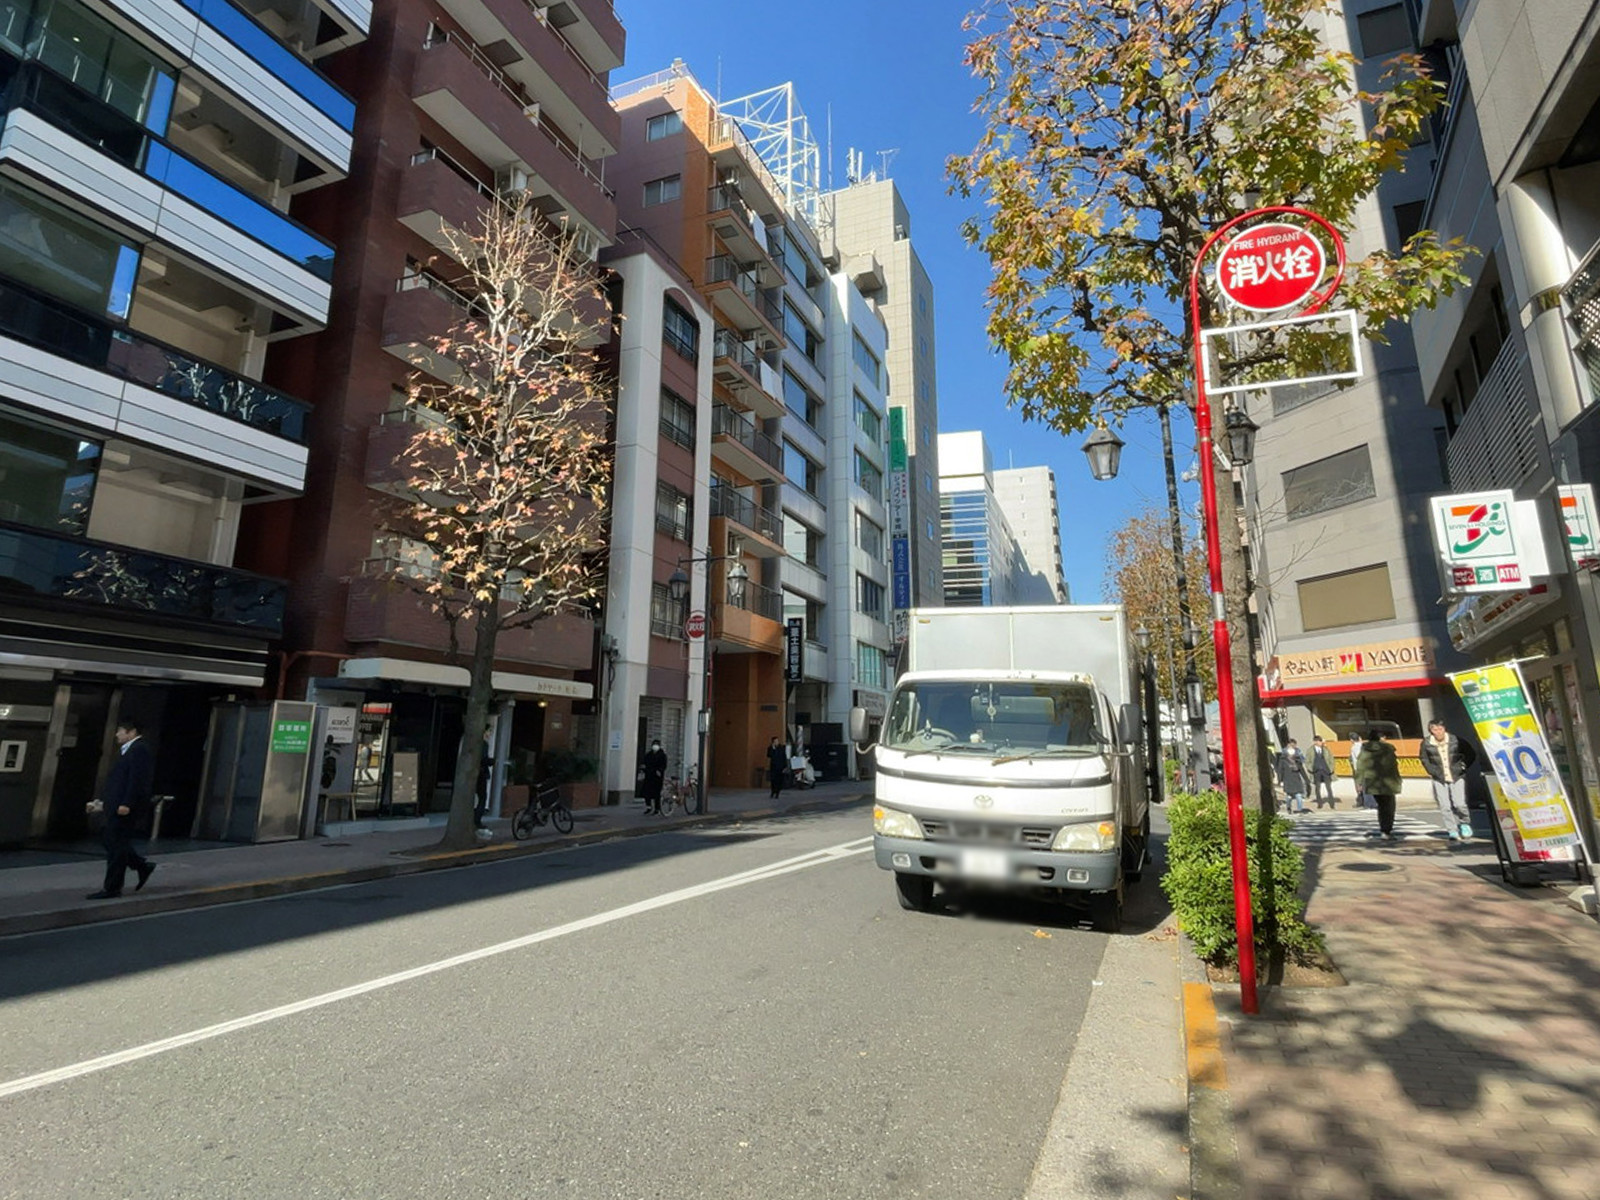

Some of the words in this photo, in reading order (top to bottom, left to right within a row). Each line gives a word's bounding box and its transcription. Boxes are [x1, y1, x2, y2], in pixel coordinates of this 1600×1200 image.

[1233, 239, 1254, 252] FIRE
[1256, 231, 1302, 248] HYDRANT
[1226, 245, 1315, 290] 消火栓
[1497, 566, 1521, 580] ATM
[1285, 655, 1335, 676] やよい軒
